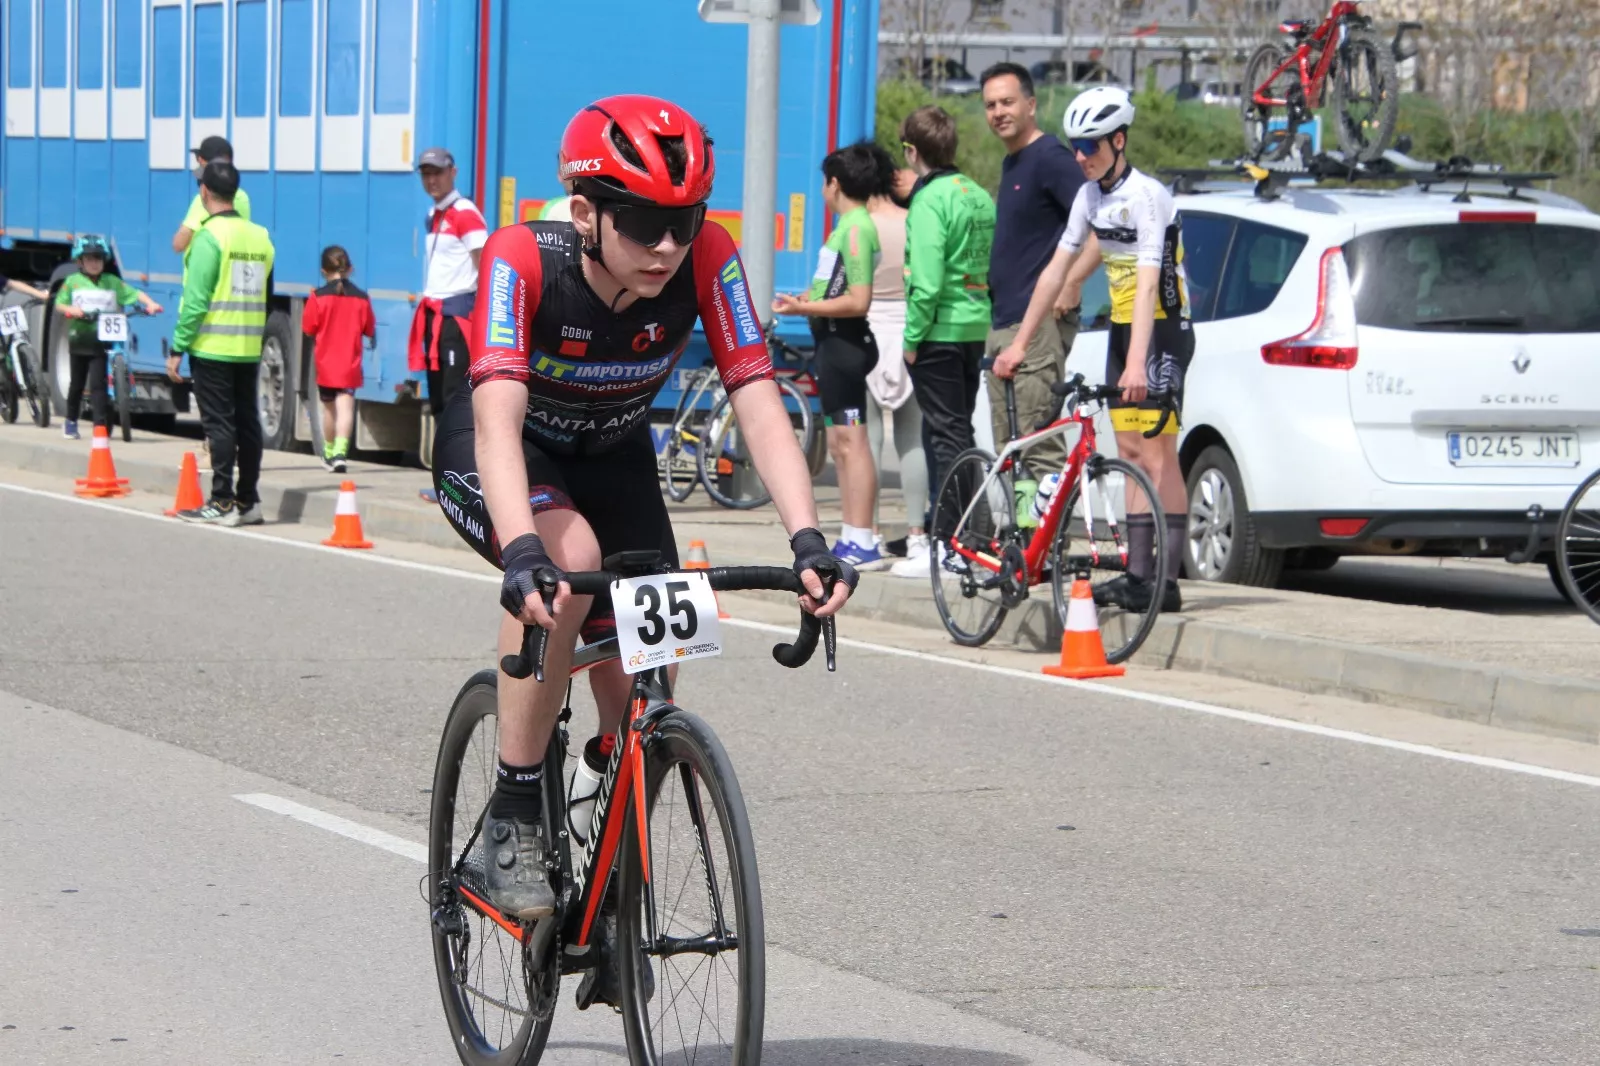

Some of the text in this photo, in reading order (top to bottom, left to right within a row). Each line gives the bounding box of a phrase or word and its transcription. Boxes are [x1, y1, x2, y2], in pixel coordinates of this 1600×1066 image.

[492, 263, 511, 322] IMPOTUSA
[3, 311, 19, 328] 87
[731, 281, 759, 342] IMPOTUSA
[104, 317, 121, 334] 85
[561, 325, 593, 341] GOBIK
[574, 357, 669, 379] IMPOTUSA
[526, 403, 596, 431] SANTA
[602, 404, 646, 429] ANA
[1465, 436, 1573, 457] 0245 JNT
[439, 489, 486, 544] SANTA ANA
[634, 581, 698, 646] 35
